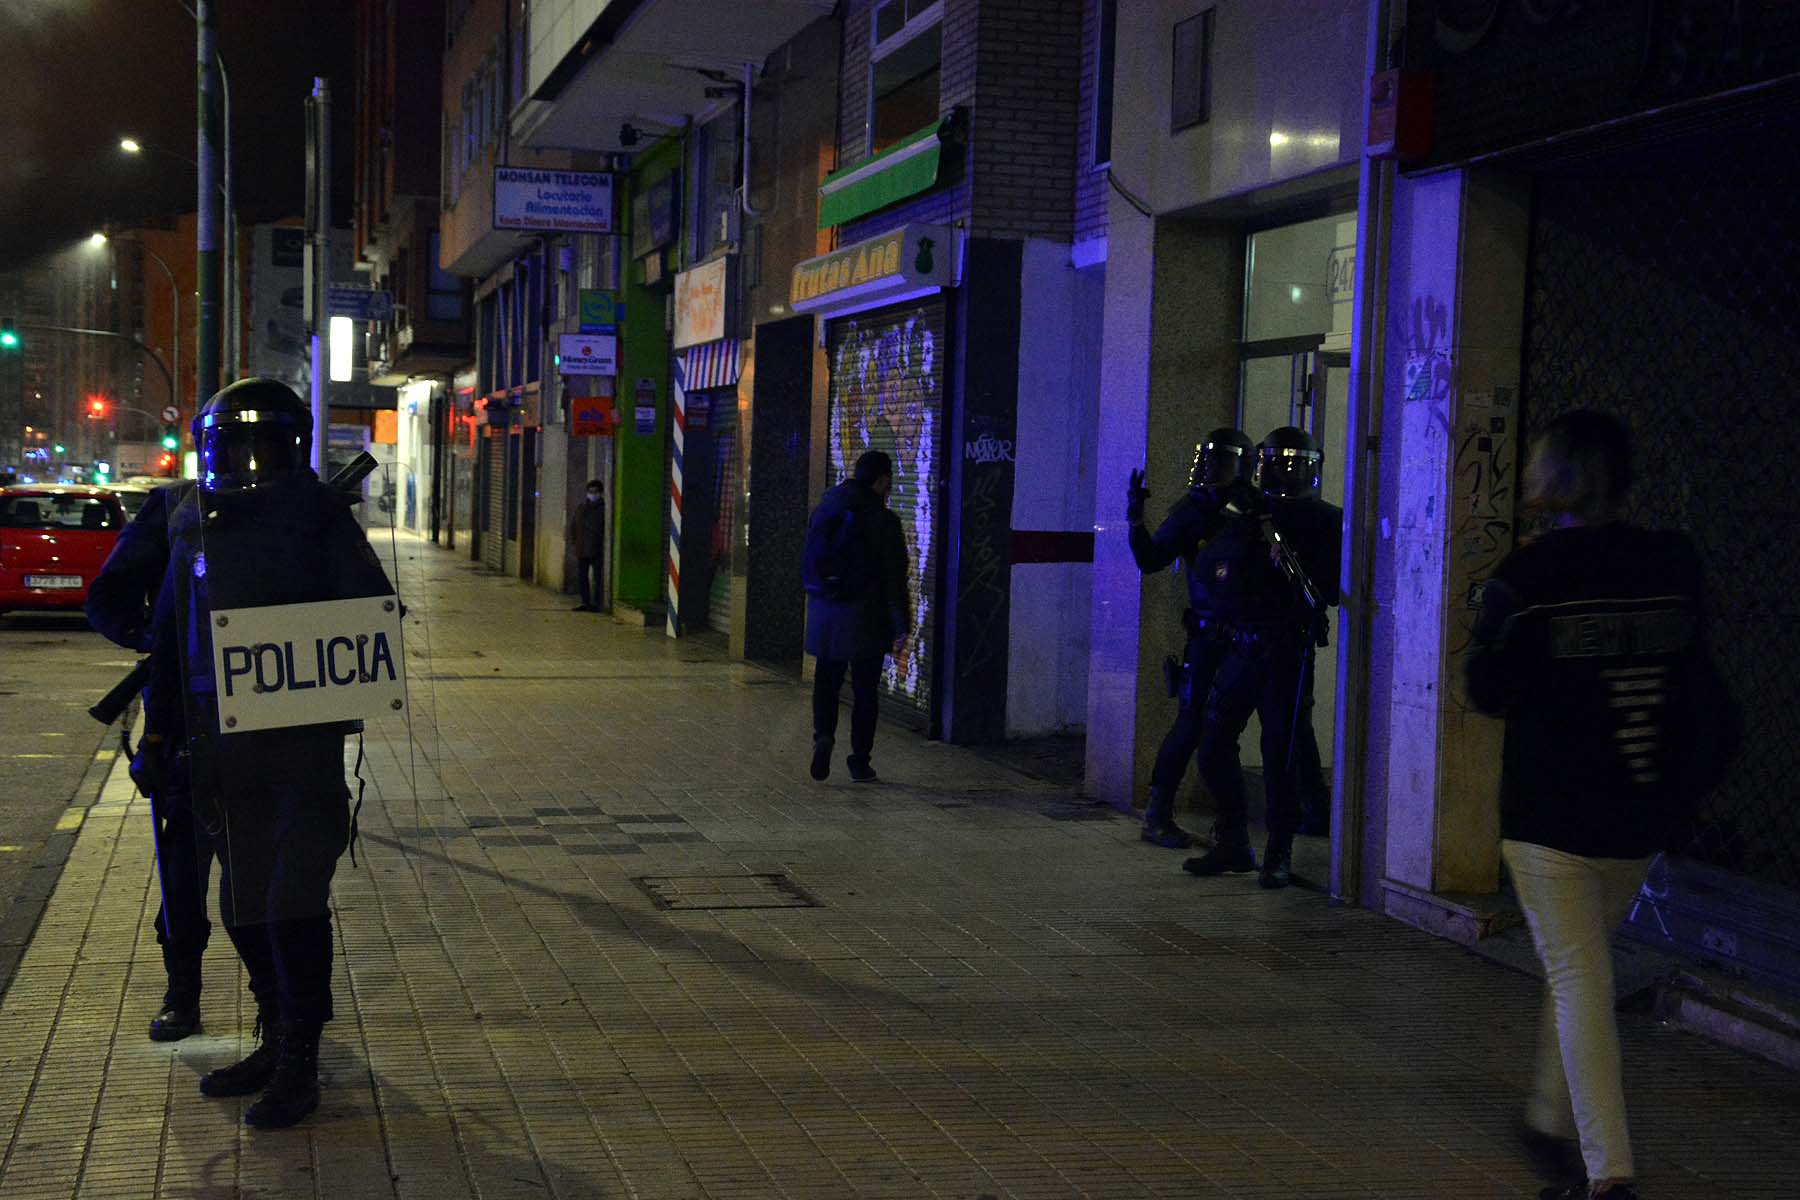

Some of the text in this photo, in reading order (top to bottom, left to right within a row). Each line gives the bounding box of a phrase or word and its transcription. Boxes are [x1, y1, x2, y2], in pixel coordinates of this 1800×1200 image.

[555, 174, 609, 187] TELECOM
[537, 188, 592, 203] Locutorio
[222, 632, 397, 697] POLICIA
